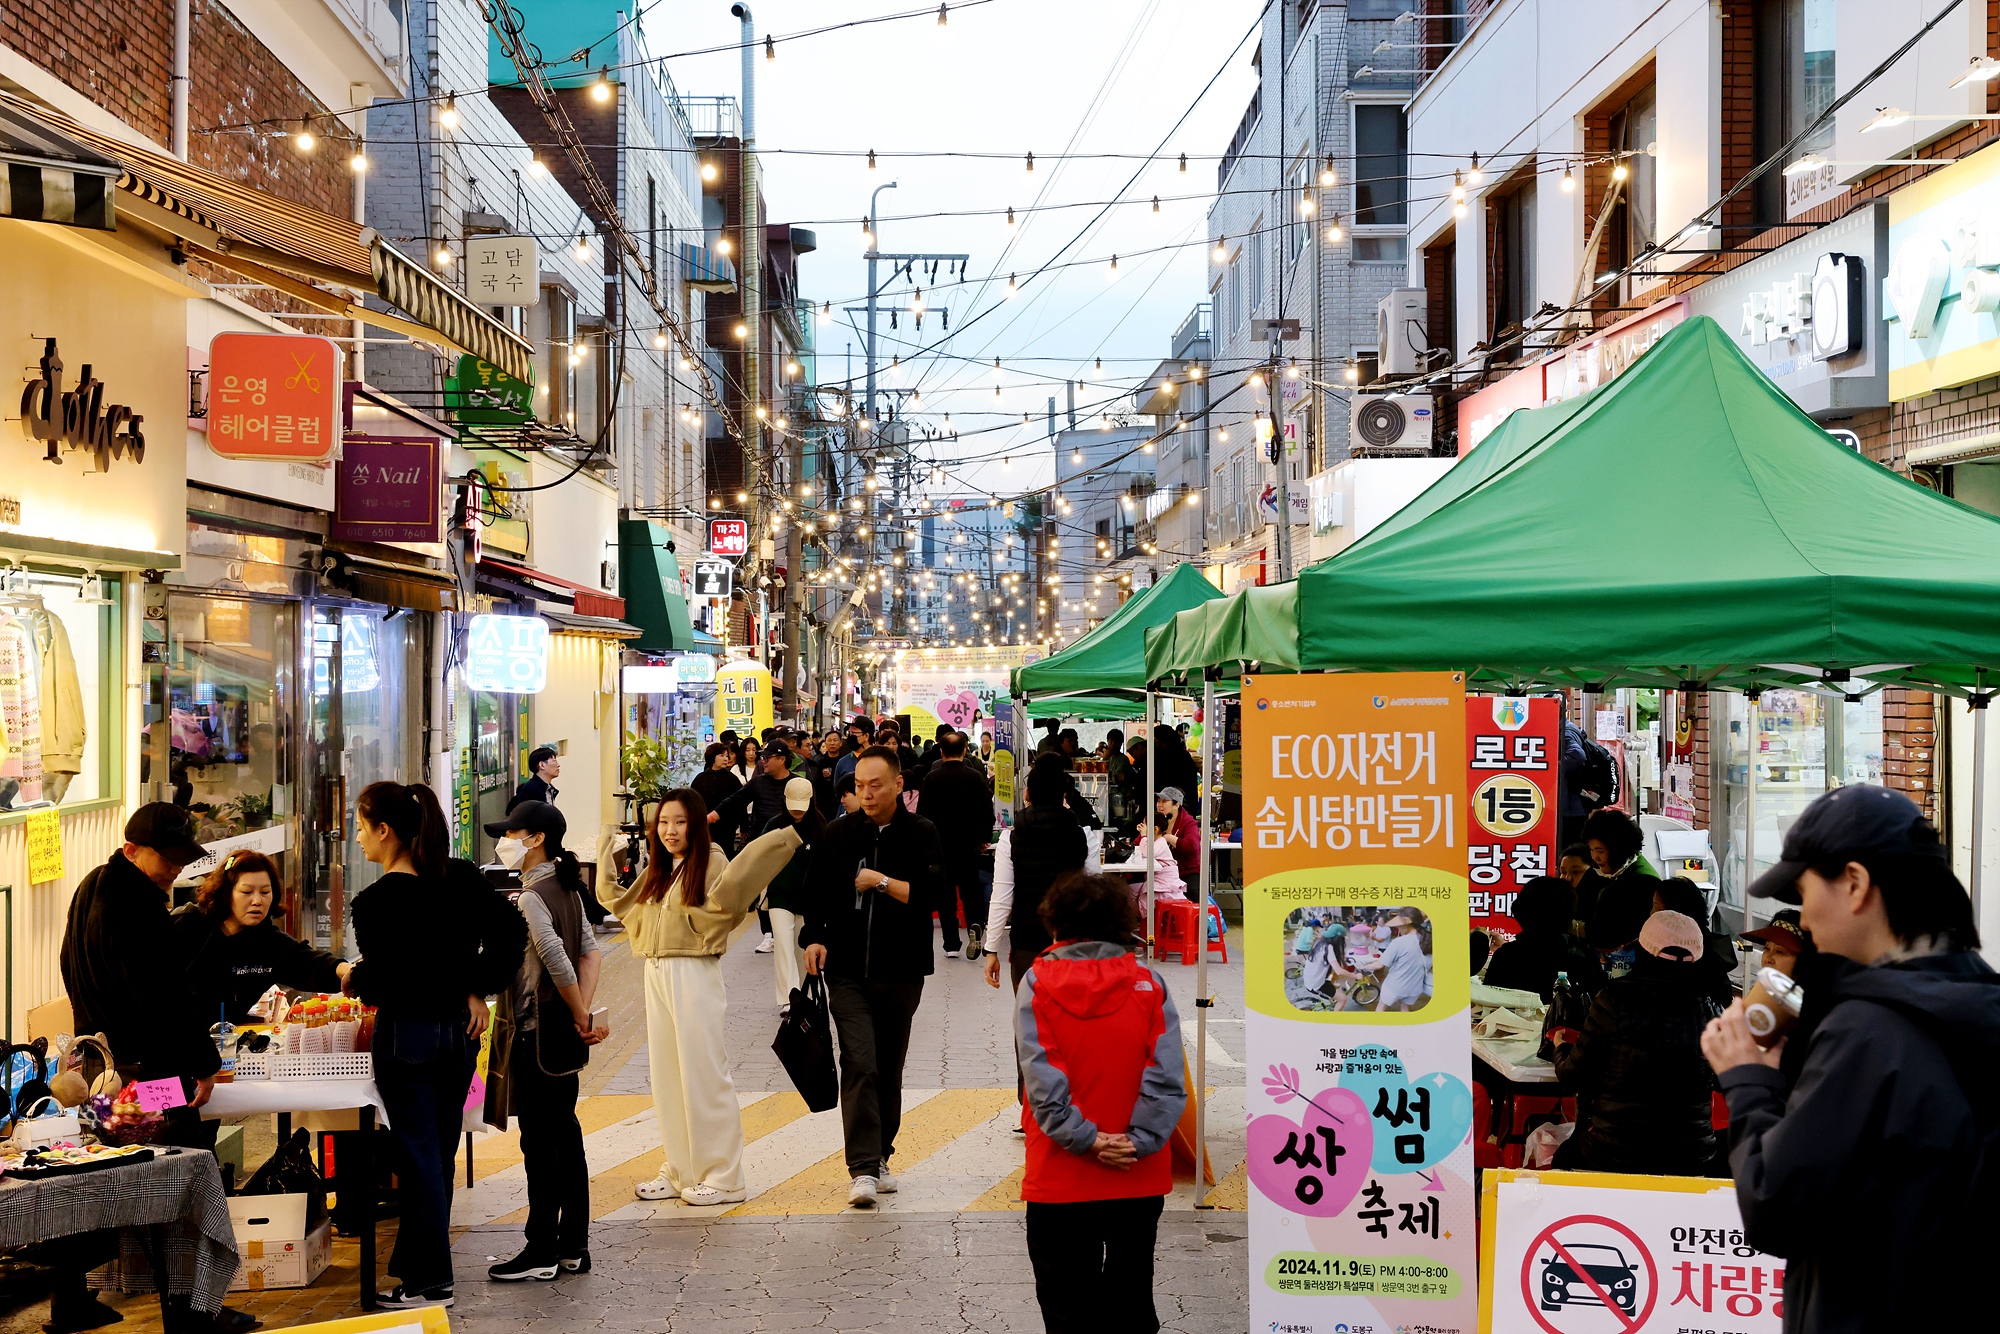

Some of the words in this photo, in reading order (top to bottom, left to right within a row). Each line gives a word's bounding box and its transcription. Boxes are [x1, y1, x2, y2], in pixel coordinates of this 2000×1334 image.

[481, 248, 523, 267] 고담
[480, 273, 523, 292] 국수
[218, 375, 268, 406] 은영
[219, 414, 320, 444] 헤어클럽
[351, 463, 370, 485] 쏭
[376, 467, 420, 484] Nail
[1291, 498, 1308, 508] 게임
[372, 528, 394, 537] 6510
[402, 528, 426, 538] 7640
[716, 524, 740, 534] 까치
[712, 535, 744, 551] 노래방
[474, 618, 541, 682] 소풍
[475, 656, 503, 666] Coffee
[475, 666, 495, 675] Beer
[680, 664, 708, 675] 머북이
[475, 676, 501, 685] Drinks
[722, 676, 759, 694] 元祖
[947, 701, 970, 724] 쌍
[1271, 699, 1317, 708] 중소벤처기업부
[1272, 731, 1436, 785] ECO자전거
[1470, 734, 1549, 770] 로또
[1481, 786, 1536, 825] 1등
[1255, 794, 1454, 850] 솜사탕만들기
[1468, 844, 1549, 886] 당첨
[1270, 886, 1323, 900] 둘러상점가
[1325, 887, 1346, 899] 구매
[1348, 886, 1380, 900] 영수증
[1382, 886, 1404, 899] 지참
[1406, 886, 1427, 899] 고객
[1430, 886, 1452, 899] 대상
[1320, 1048, 1337, 1059] 가을
[1339, 1049, 1357, 1059] 밤의
[1360, 1048, 1378, 1060] 낭만
[1380, 1049, 1398, 1059] 속에
[1315, 1063, 1343, 1074] 사랑과
[1345, 1063, 1382, 1074] 즐거움이
[1384, 1063, 1403, 1075] 있는
[1372, 1086, 1431, 1164] 썸
[1273, 1125, 1347, 1205] 쌍
[1357, 1179, 1440, 1240] 축제
[1670, 1226, 1762, 1258] 안전행
[1278, 1258, 1376, 1277] 2024.11.9(토)
[1380, 1266, 1396, 1277] PM
[1398, 1266, 1449, 1278] 4:00~8:00
[1278, 1279, 1302, 1290] 쌍문역
[1303, 1279, 1342, 1291] 둘러상점가
[1343, 1280, 1375, 1292] 특설무대
[1381, 1282, 1405, 1293] 쌍문역
[1406, 1282, 1420, 1293] 3번
[1421, 1283, 1437, 1294] 출구
[1438, 1283, 1448, 1294] 앞
[1279, 1325, 1313, 1334] 서울특별시
[1351, 1325, 1374, 1334] 도봉구
